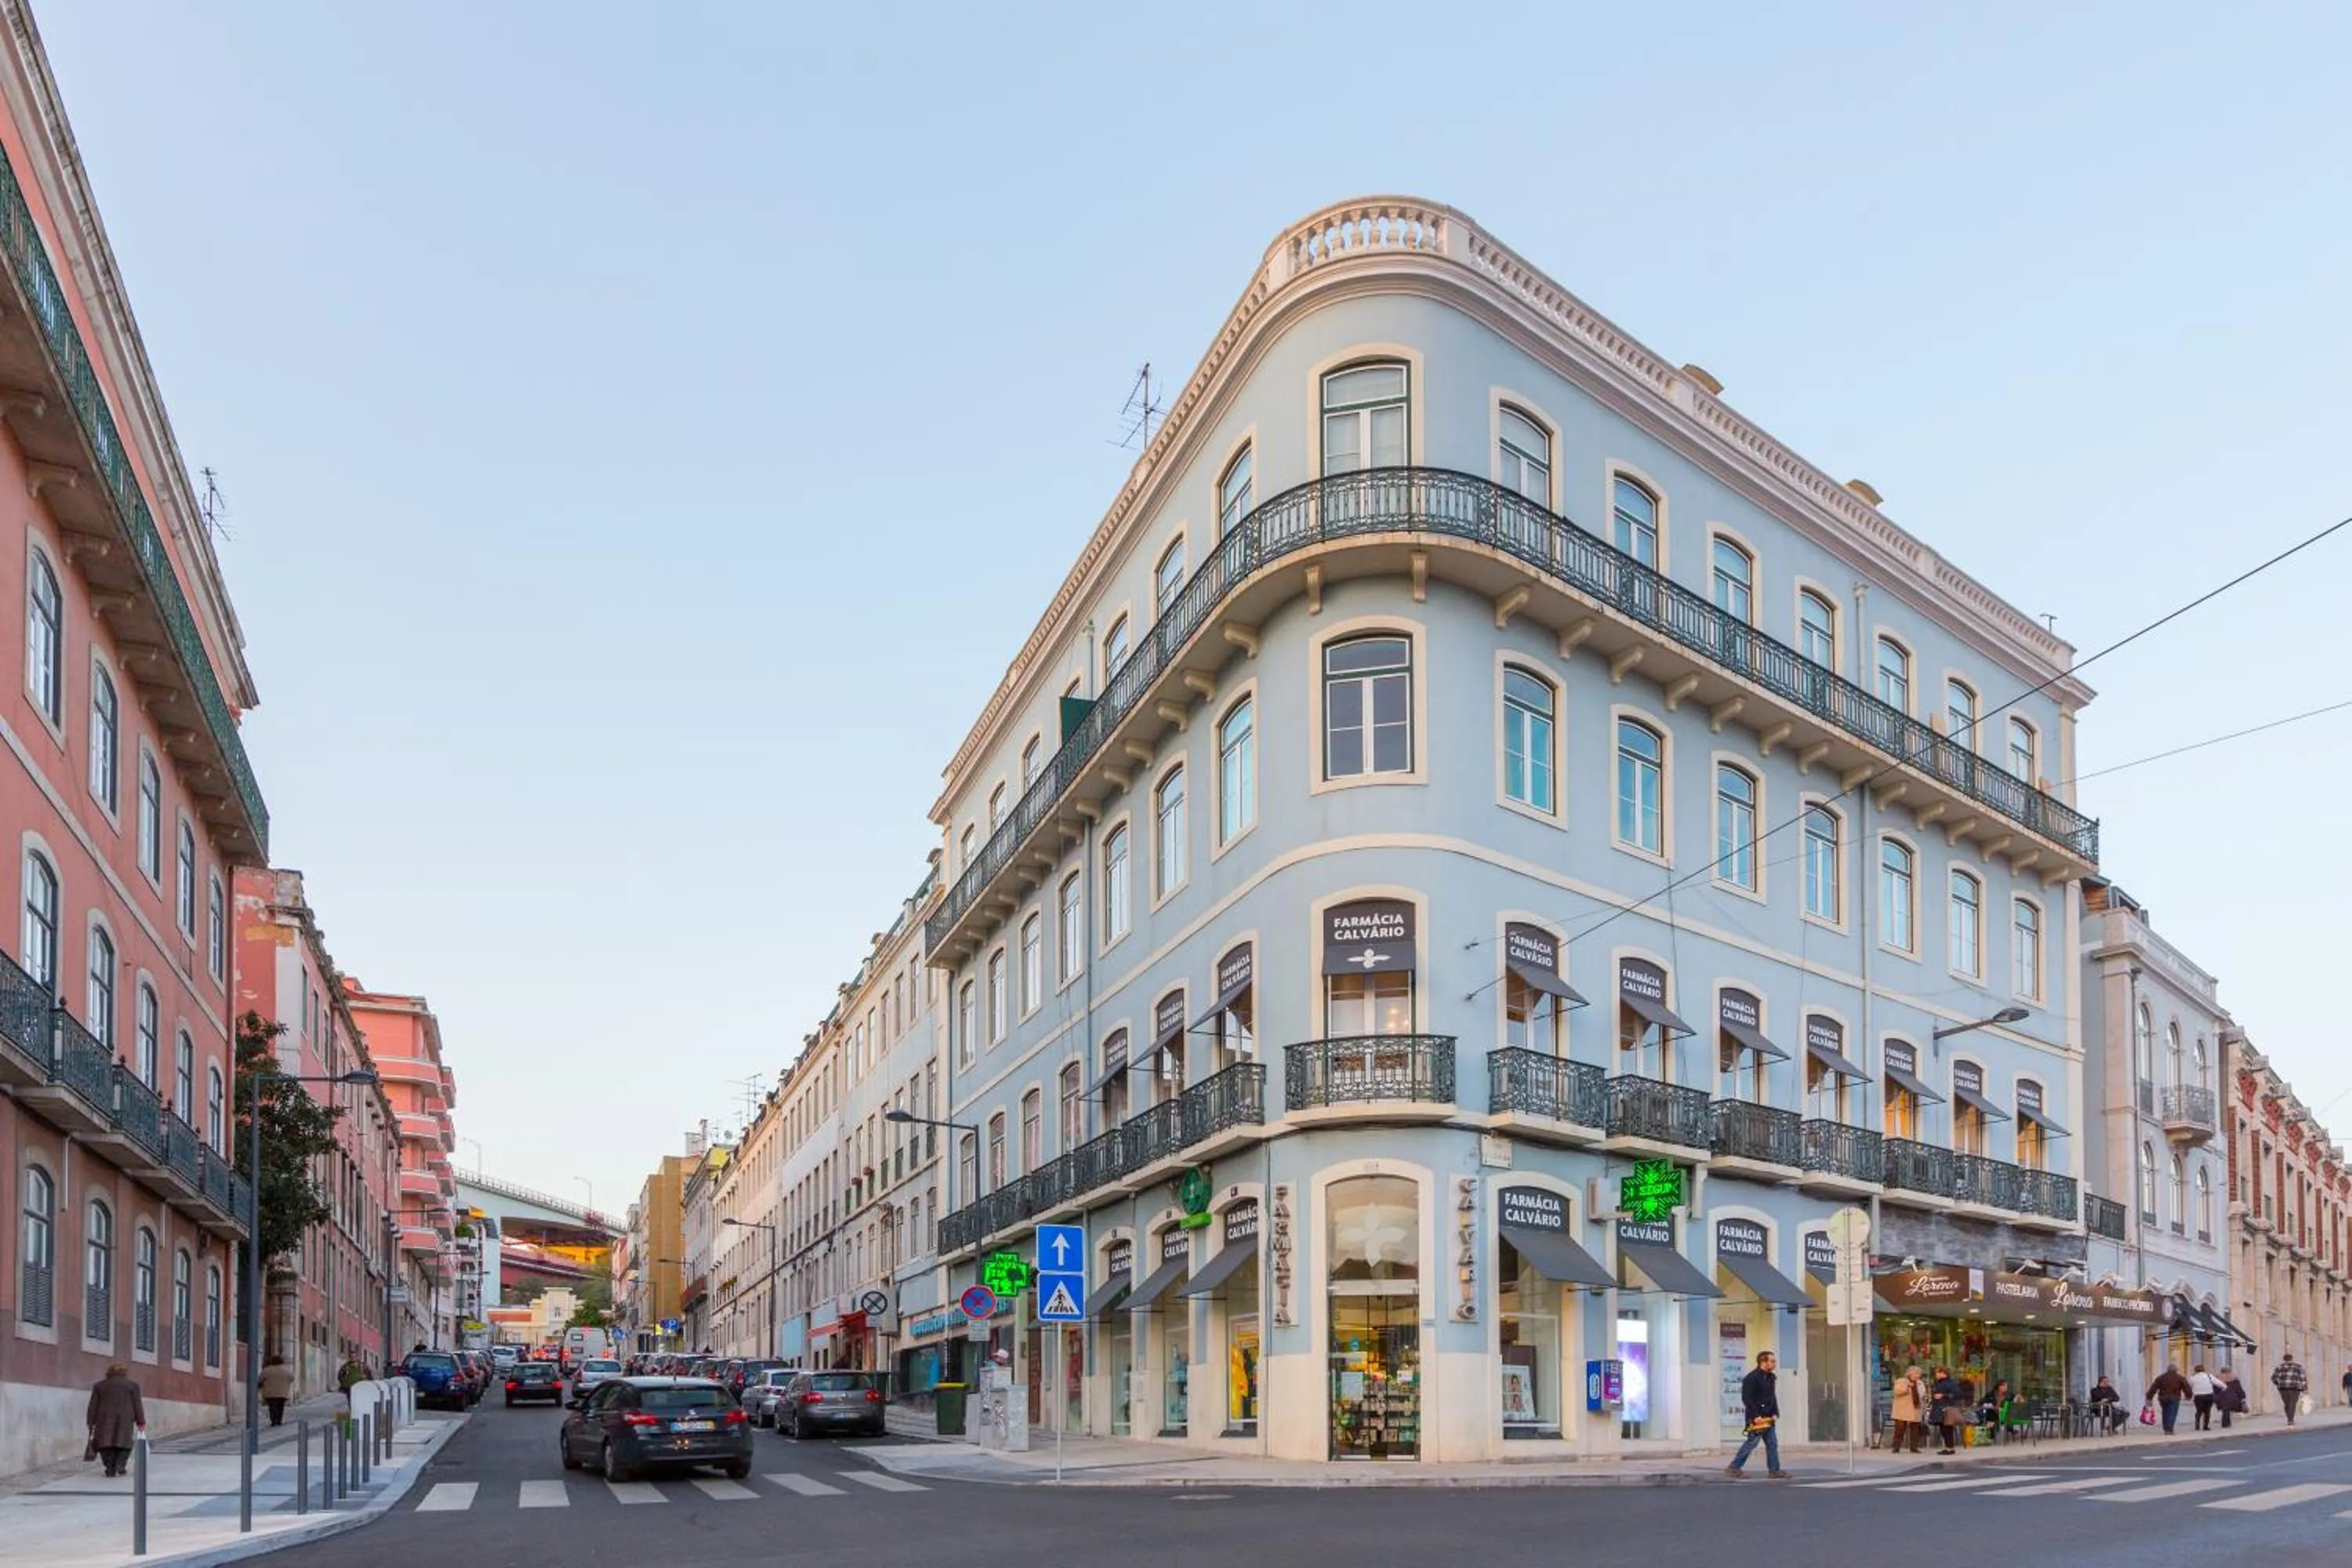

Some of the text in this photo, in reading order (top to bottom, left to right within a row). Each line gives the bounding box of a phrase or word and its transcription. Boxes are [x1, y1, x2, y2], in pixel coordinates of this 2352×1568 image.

[1334, 913, 1404, 927] FARMÁCIA
[1334, 927, 1405, 940] CALVÁRIO
[1509, 931, 1552, 955] FARMÁCIA
[1509, 946, 1552, 967] CALVÁRIO
[1622, 980, 1661, 999] CALVÁRIO
[1504, 1192, 1561, 1212] FARMÁCIA
[1504, 1208, 1561, 1227] CALVÁRIO
[1621, 1225, 1669, 1243] CALVÁRIO
[1719, 1225, 1762, 1241] FARMÁCIA
[1273, 1186, 1292, 1326] FARMÁCIA
[1457, 1178, 1477, 1319] CALVÁRIO
[1719, 1239, 1763, 1255] CALVÁRIO
[1905, 1276, 1960, 1298] Lorena
[1995, 1282, 2039, 1298] PASTELARIA
[2050, 1282, 2094, 1312] Lorena
